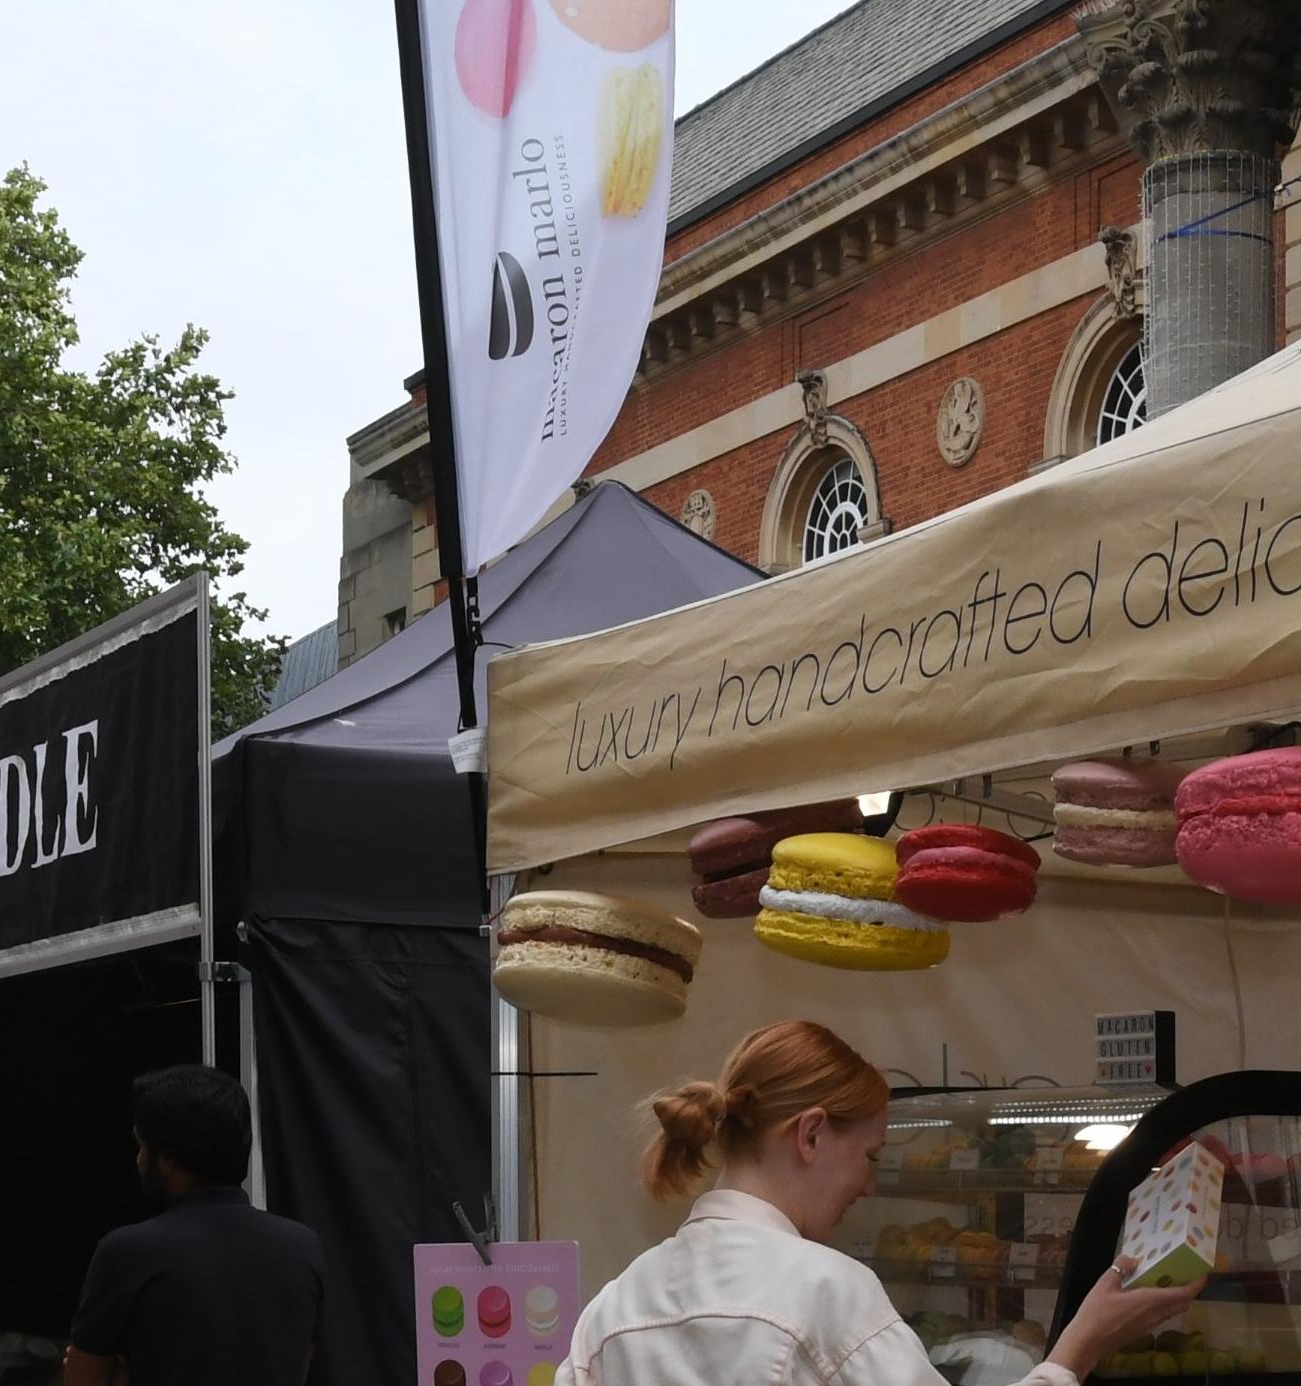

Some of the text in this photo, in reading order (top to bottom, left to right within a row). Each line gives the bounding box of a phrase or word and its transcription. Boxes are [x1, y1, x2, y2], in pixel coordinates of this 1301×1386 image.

[553, 135, 581, 257] DELICIOUSNESS
[512, 138, 569, 442] macaron marlo
[559, 380, 568, 436] LUXURY
[566, 686, 702, 775] luxury
[707, 539, 1101, 737] handcrafted
[1100, 1040, 1150, 1057] GLUTEN
[1110, 1063, 1142, 1079] FREE
